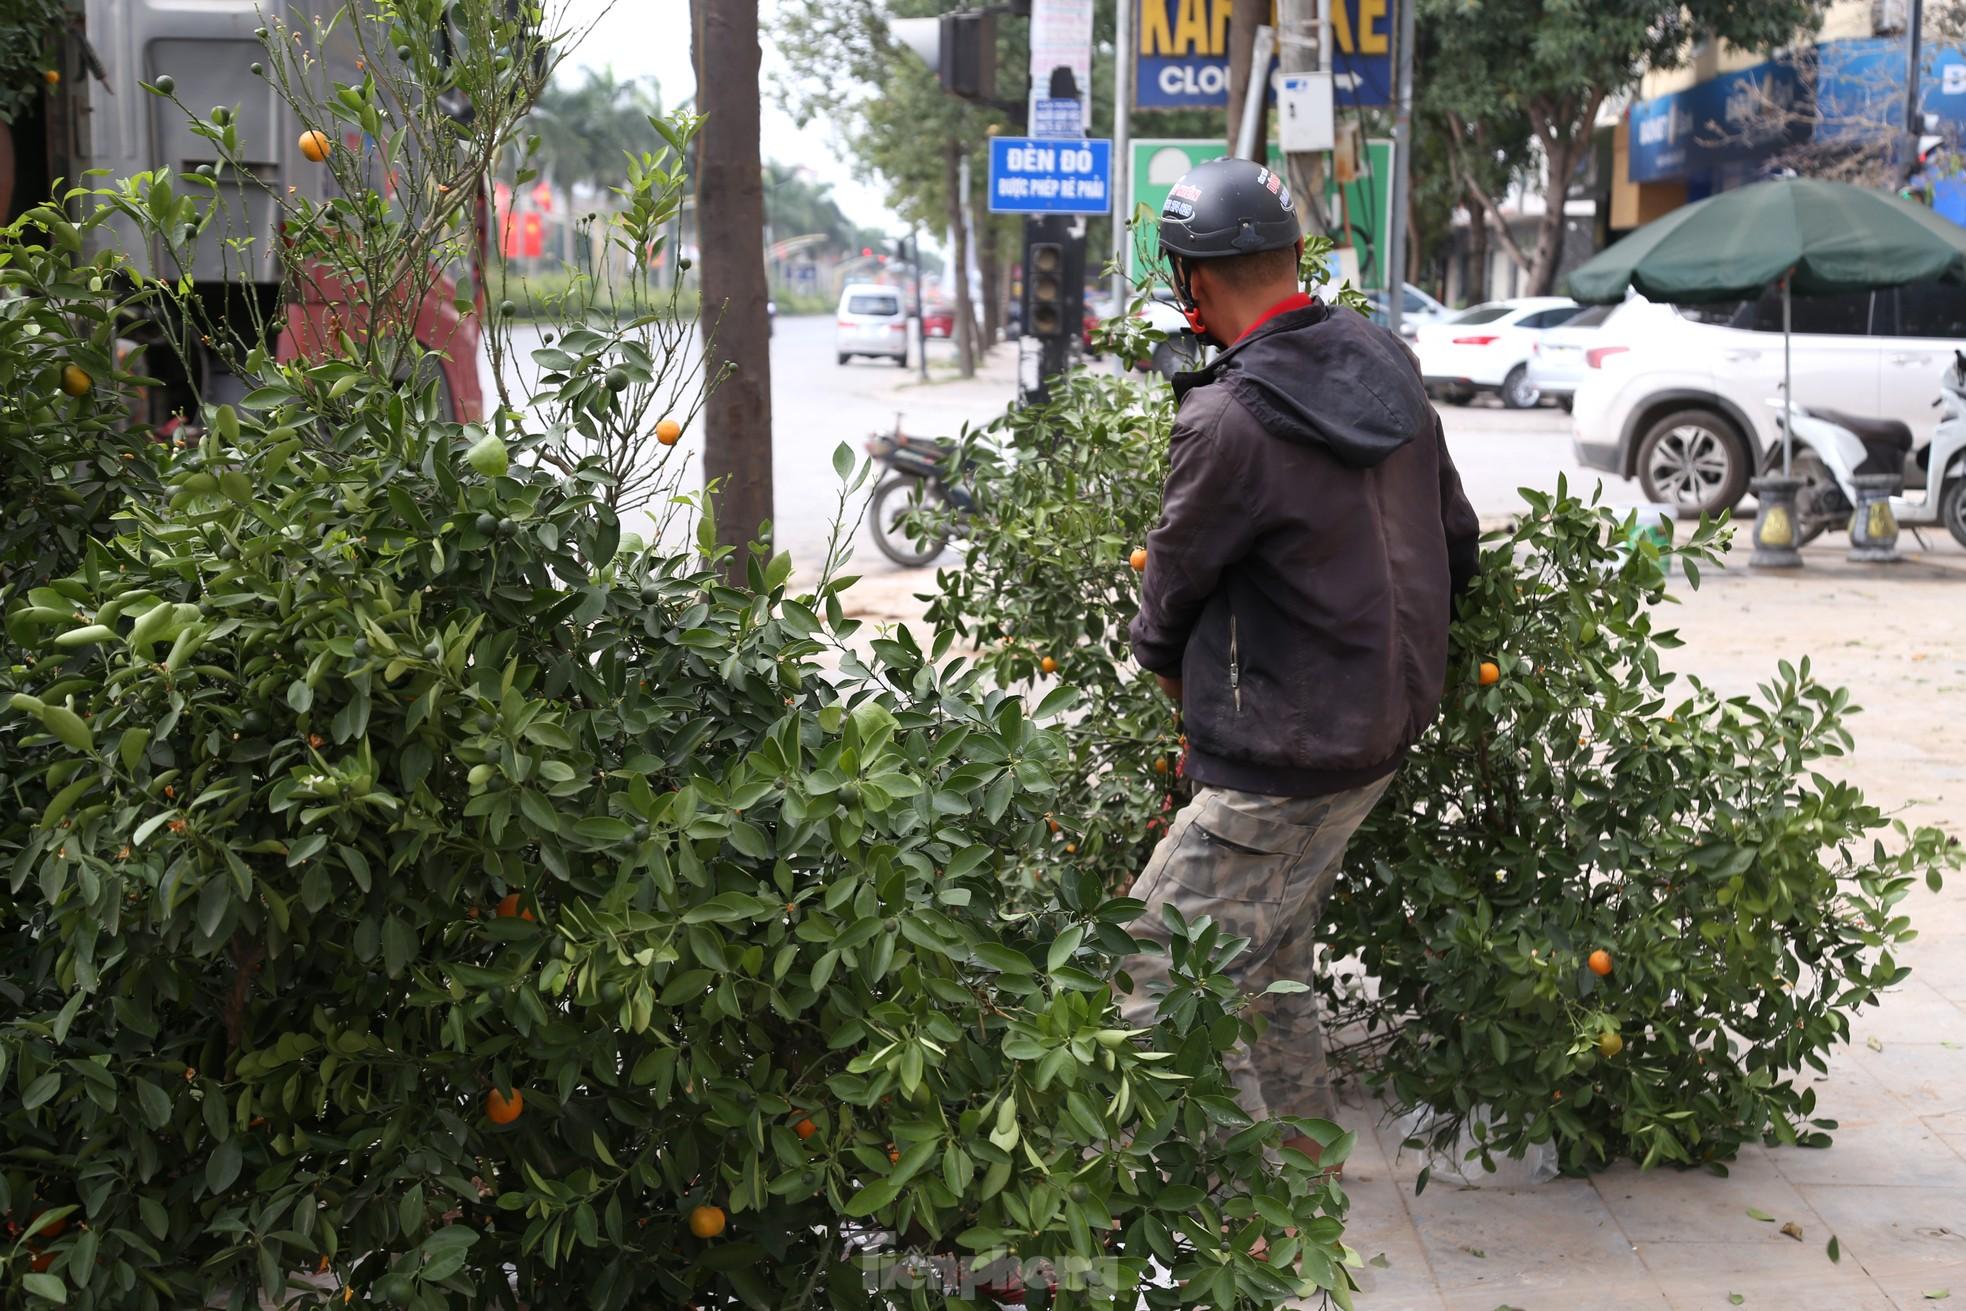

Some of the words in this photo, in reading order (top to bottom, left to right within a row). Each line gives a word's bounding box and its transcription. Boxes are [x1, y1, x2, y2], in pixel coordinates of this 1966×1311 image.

[1007, 142, 1055, 173] ĐÈN
[1060, 141, 1093, 174] ĐỎ
[1030, 175, 1060, 199] PHÉP
